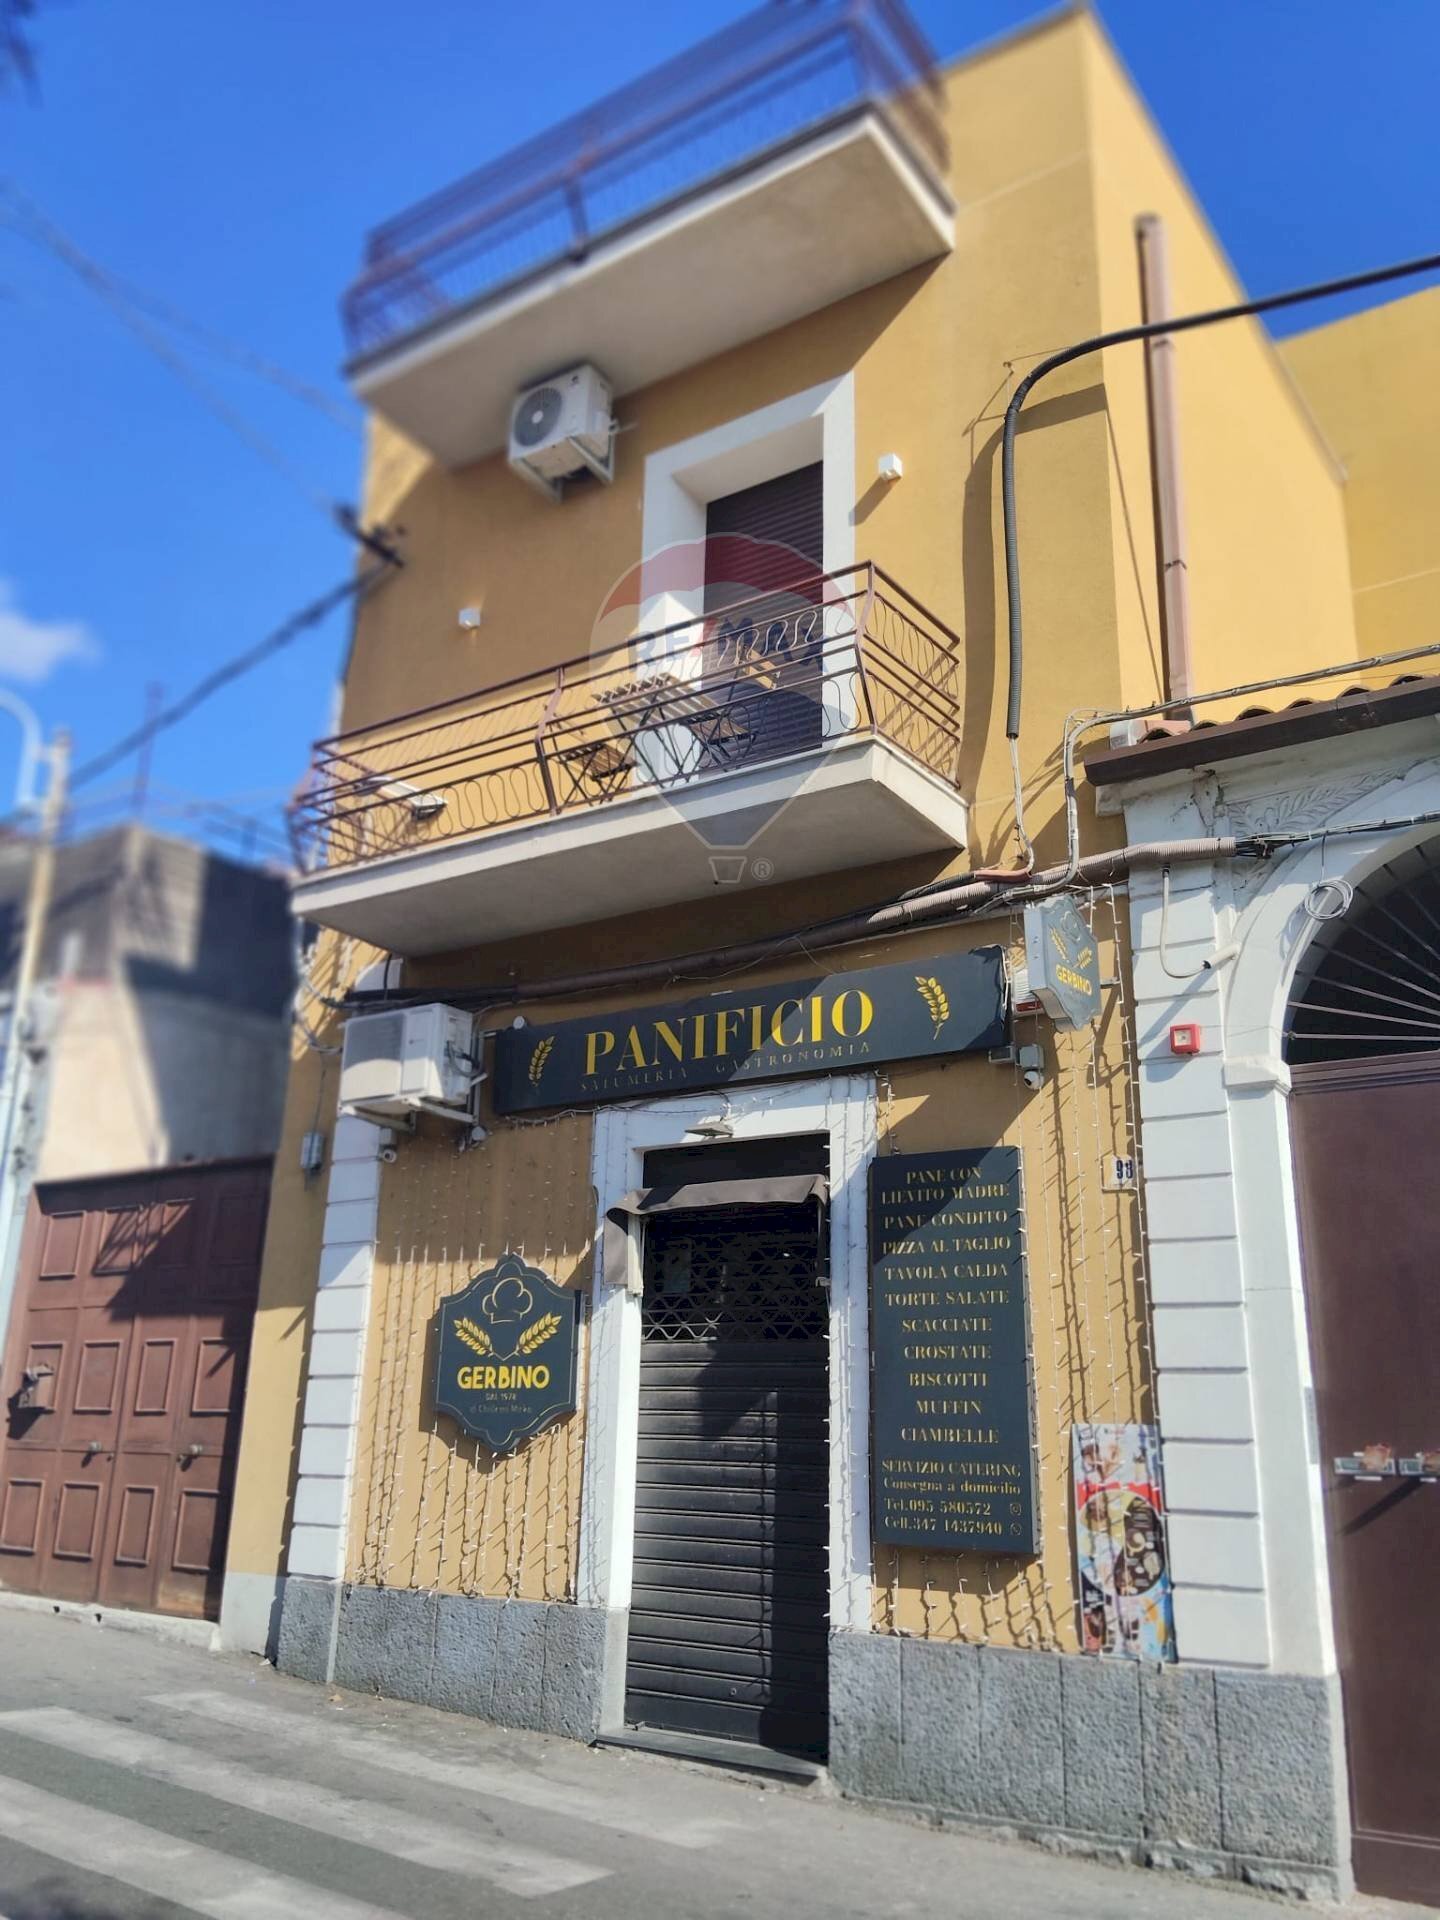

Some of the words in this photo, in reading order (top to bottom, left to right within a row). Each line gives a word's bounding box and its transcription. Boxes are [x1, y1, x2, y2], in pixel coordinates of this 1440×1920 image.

[1055, 963, 1092, 996] GERBINO
[584, 989, 874, 1076] PANIFICIO
[581, 1067, 687, 1091] SALUMERIA
[715, 1041, 870, 1073] GASTRONOMIA
[906, 1169, 945, 1184] PANE
[950, 1167, 983, 1181] CON
[882, 1188, 945, 1205] LIEVITO
[952, 1184, 1010, 1200] MADRE
[885, 1215, 926, 1229] PANE
[931, 1210, 1008, 1226] CONDITO
[882, 1241, 925, 1255] PIZZA
[932, 1239, 949, 1253] AL
[952, 1236, 1011, 1252] TAGLIO
[885, 1265, 947, 1281] TAVOLA
[954, 1263, 1008, 1278] CALDA
[885, 1292, 940, 1307] TORTE
[946, 1290, 1009, 1305] SALATE
[902, 1318, 992, 1332] SCACCIATE
[904, 1345, 992, 1359] CROSTATE
[457, 1365, 550, 1390] GERBINO
[909, 1373, 988, 1387] BISCOTTI
[916, 1400, 983, 1415] MUFFIN
[901, 1428, 999, 1444] CIAMBELLE
[882, 1460, 944, 1474] SERVIZIO
[949, 1462, 1021, 1477] CATERING
[884, 1477, 942, 1493] Consegna
[947, 1482, 956, 1492] a
[960, 1480, 1020, 1494] domicilio
